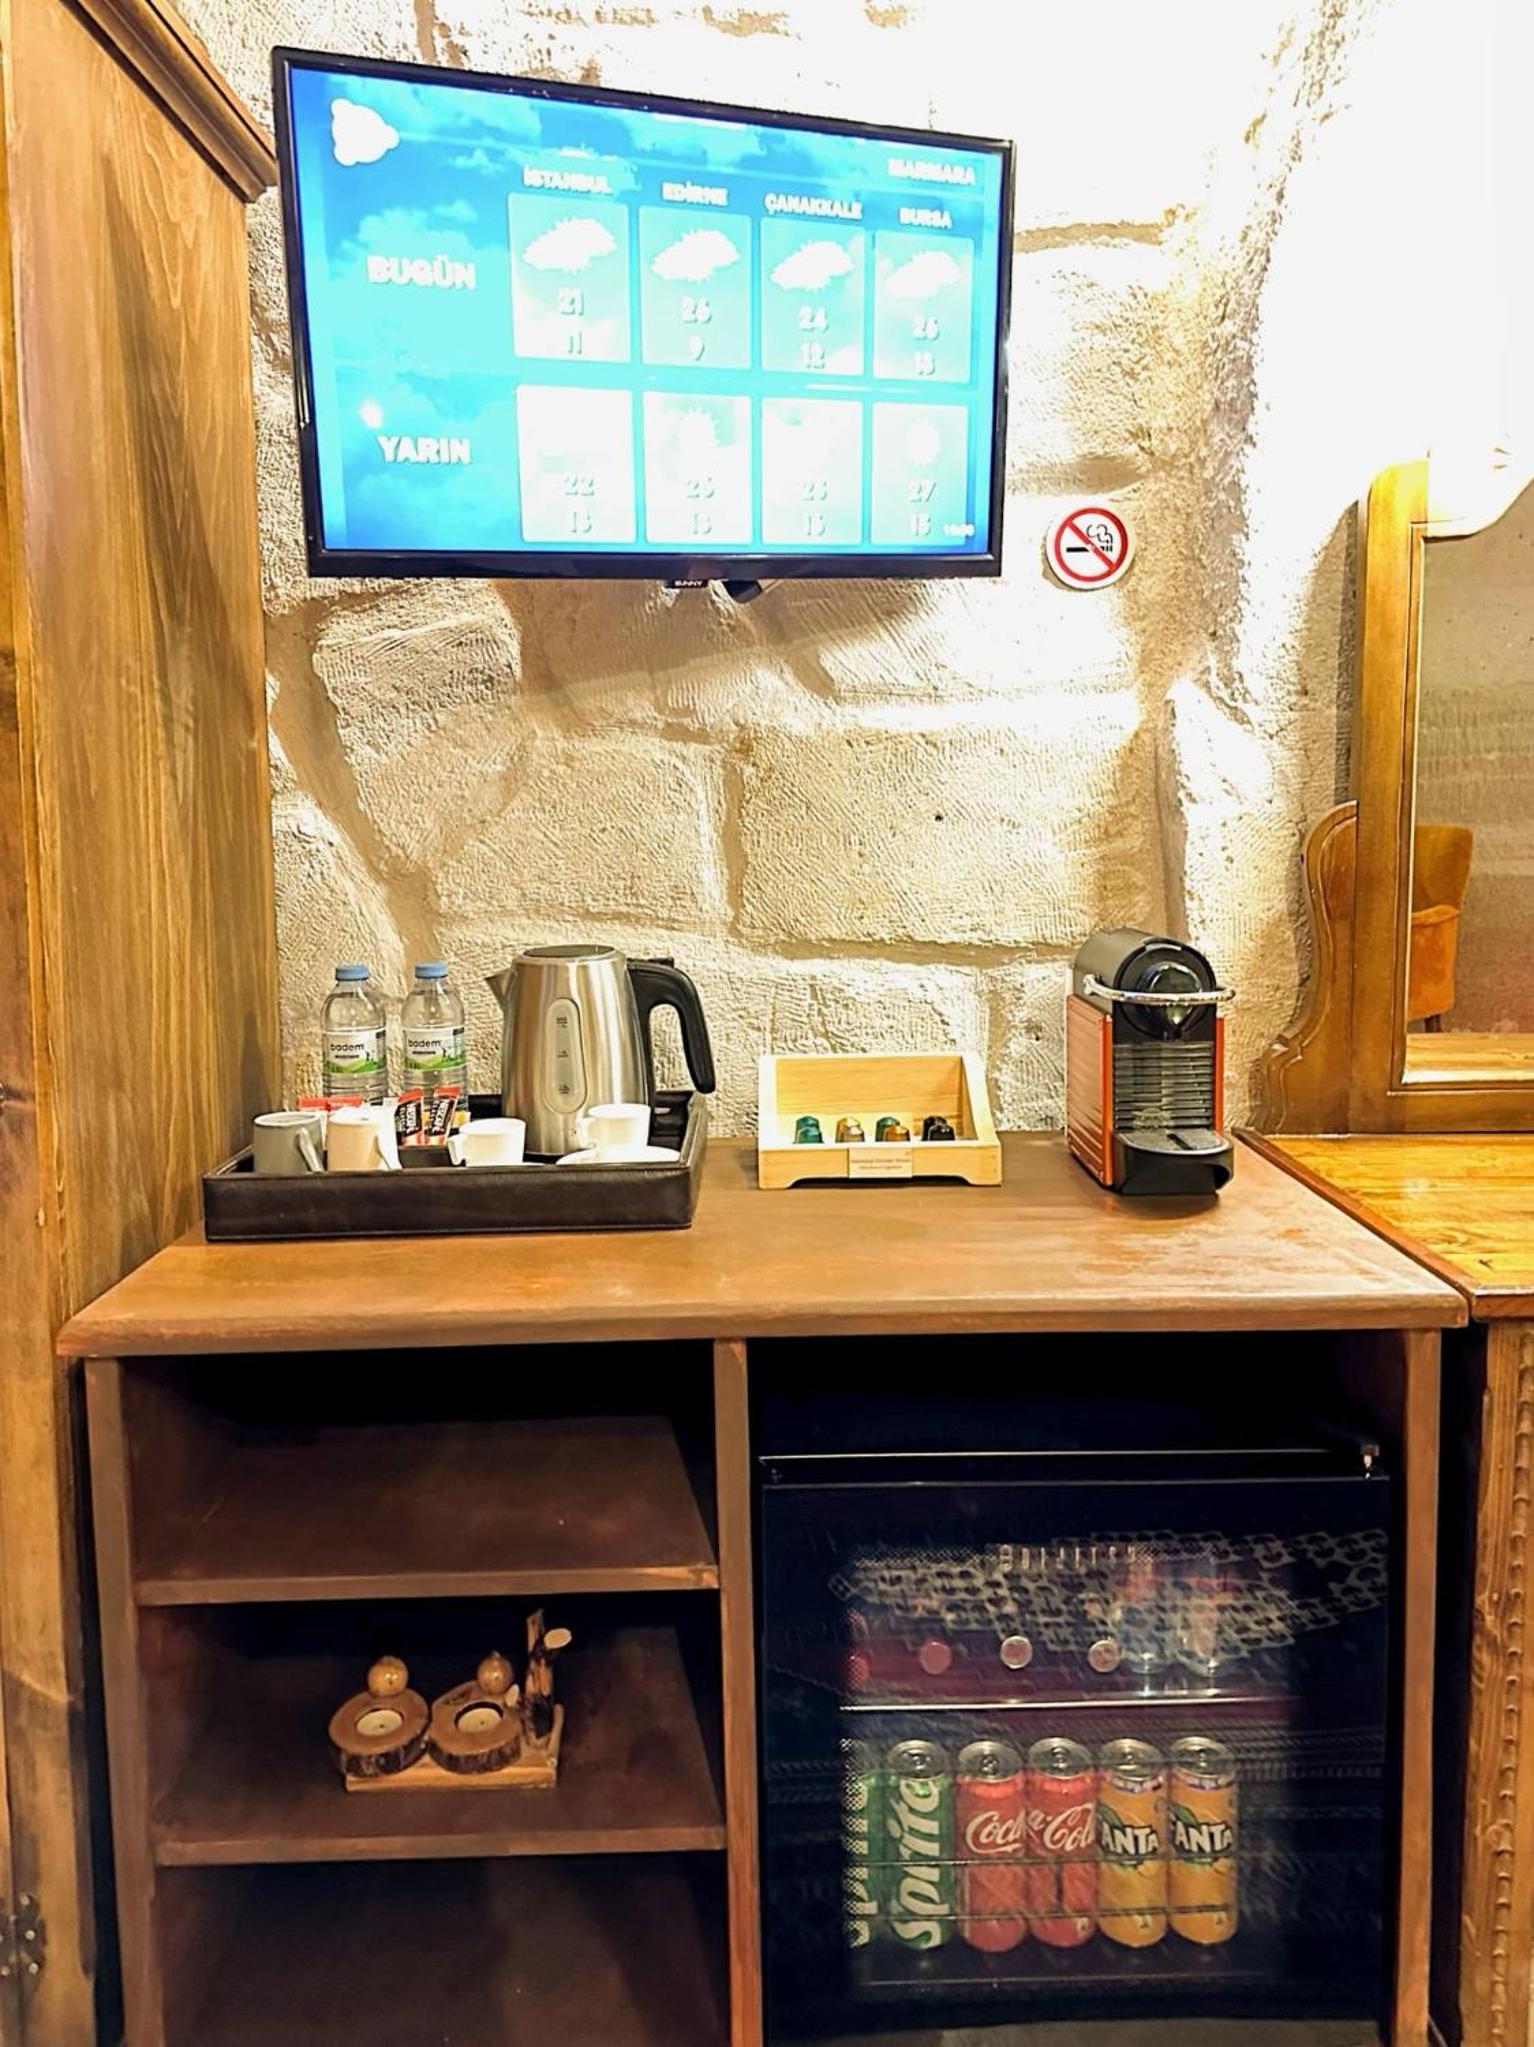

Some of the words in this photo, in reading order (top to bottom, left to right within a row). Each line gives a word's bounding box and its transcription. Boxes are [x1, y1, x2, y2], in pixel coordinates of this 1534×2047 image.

[764, 193, 863, 220] ÇANAKKALE
[899, 207, 952, 229] BURSA
[366, 254, 476, 291] BUGÜN
[376, 435, 471, 465] YARIN
[330, 1043, 365, 1052] badem
[407, 1039, 442, 1048] badem
[1101, 1820, 1160, 1856] ANTA
[1174, 1820, 1234, 1854] ANTA
